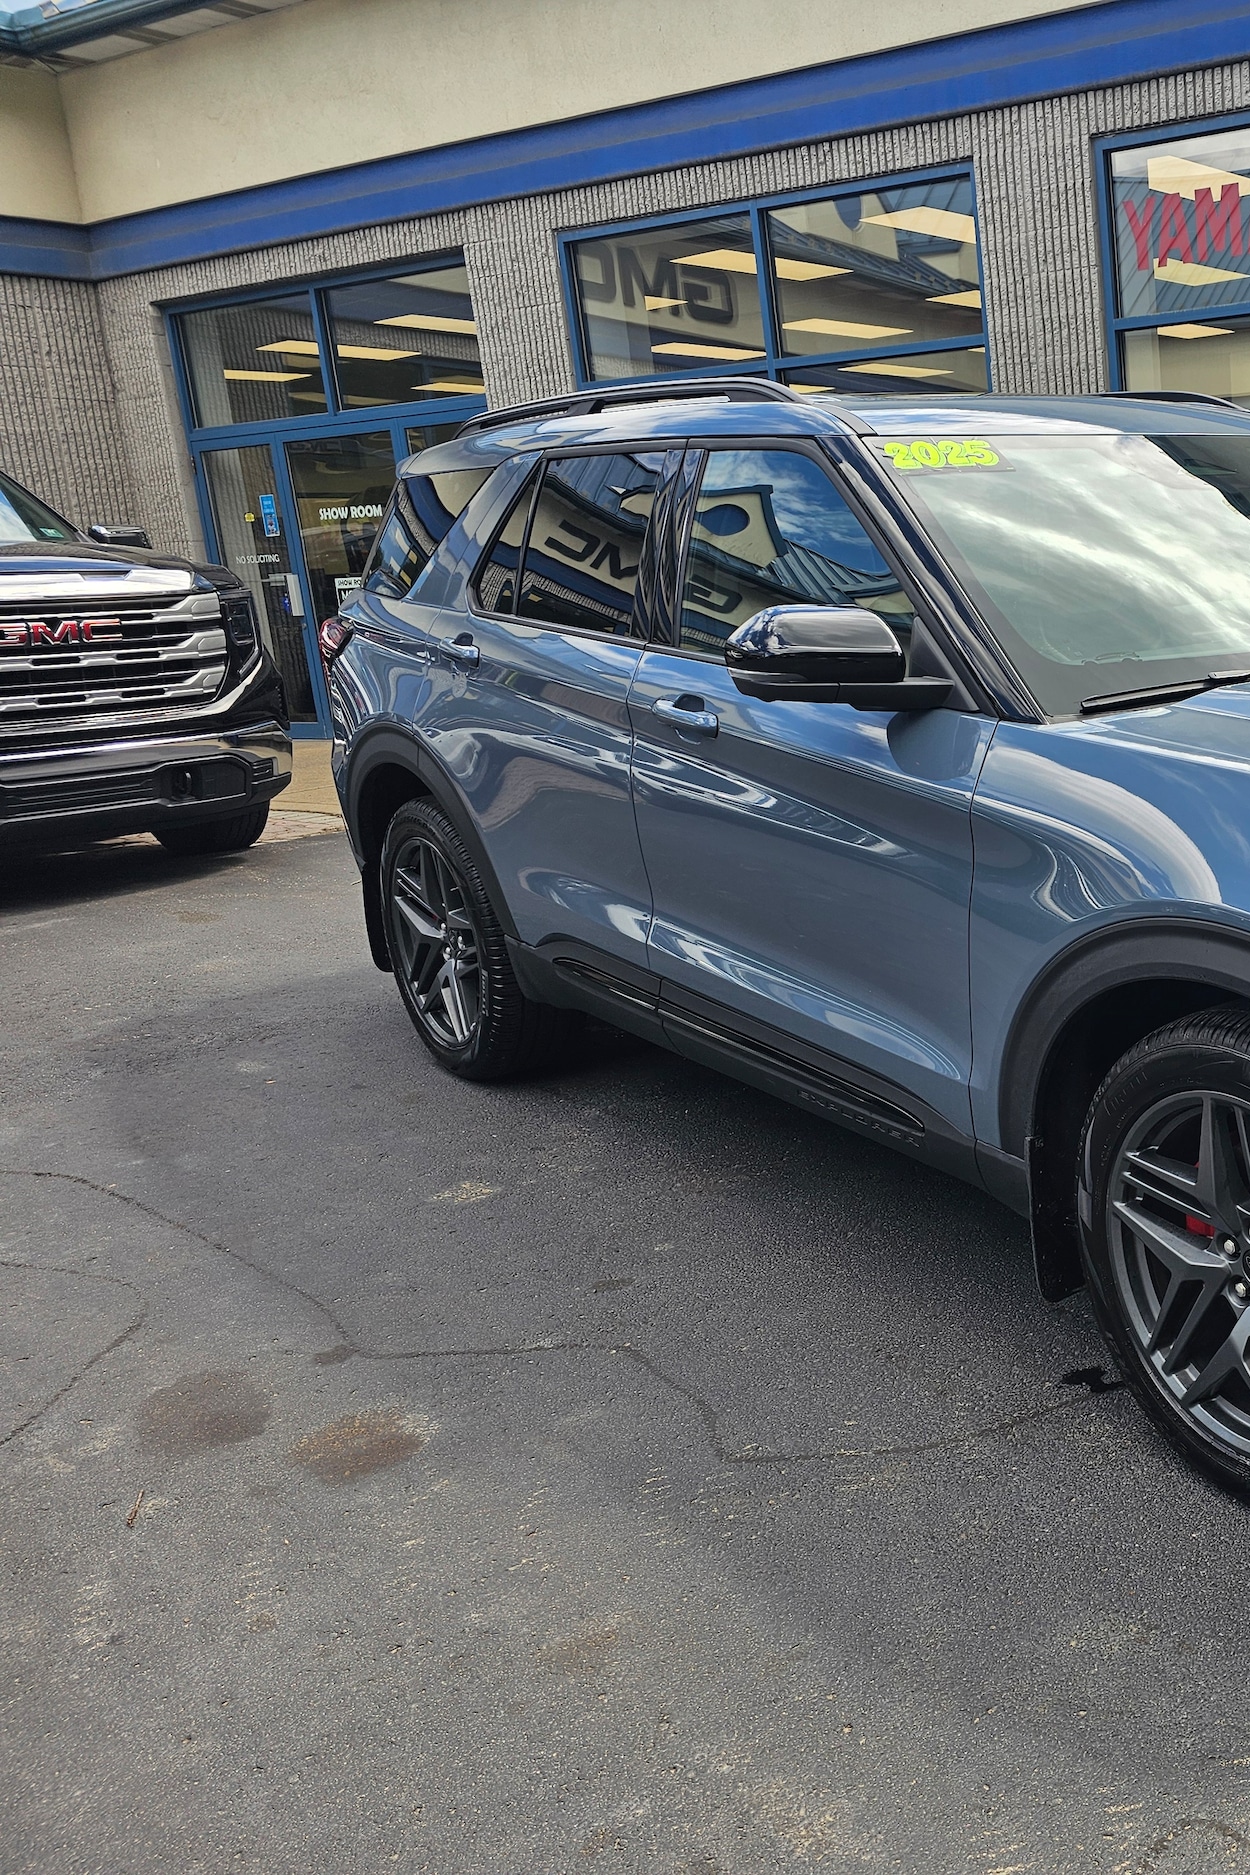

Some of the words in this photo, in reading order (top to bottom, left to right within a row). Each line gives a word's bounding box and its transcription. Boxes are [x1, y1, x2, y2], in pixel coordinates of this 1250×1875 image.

[883, 440, 1000, 470] 2025
[318, 506, 348, 521] SHOW
[350, 504, 383, 519] ROOM
[236, 555, 245, 565] NO
[246, 553, 280, 565] SOLICITING
[0, 618, 122, 647] GMC
